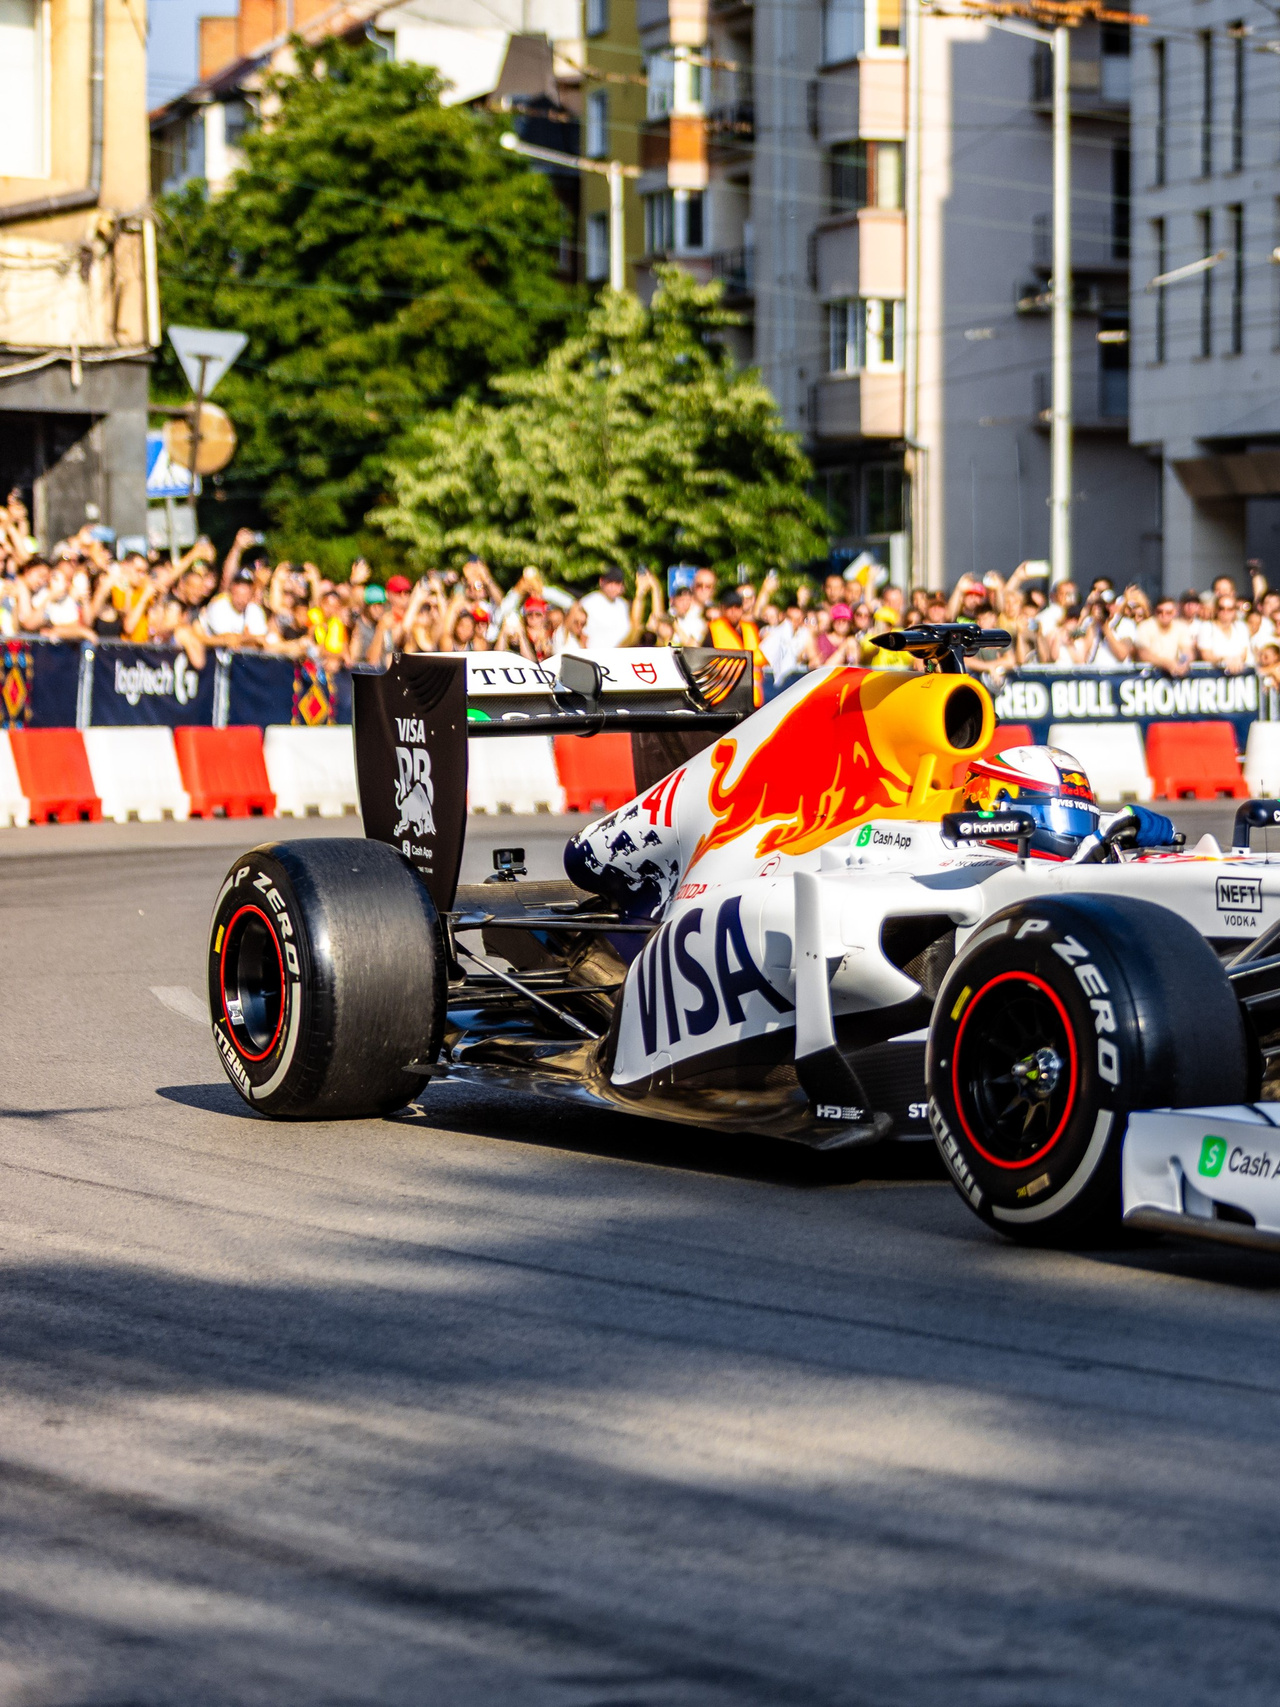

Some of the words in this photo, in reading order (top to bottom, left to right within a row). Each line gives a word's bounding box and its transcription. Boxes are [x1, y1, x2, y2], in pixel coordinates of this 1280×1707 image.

[472, 665, 618, 686] TUDR
[995, 681, 1048, 719] RED
[1051, 679, 1117, 717] BULL
[1119, 675, 1258, 717] SHOWRUN
[395, 718, 426, 743] VISA
[642, 767, 687, 828] 41
[873, 831, 893, 847] Cash
[894, 833, 912, 850] App
[973, 822, 1019, 834] hahnair
[1220, 884, 1256, 904] NEFT
[234, 866, 250, 887] P
[253, 871, 300, 976] ZERO
[1224, 914, 1257, 927] VODKA
[636, 895, 796, 1057] VISA
[1014, 919, 1050, 940] P
[1051, 935, 1120, 1085] ZERO
[1228, 1147, 1271, 1176] Cash
